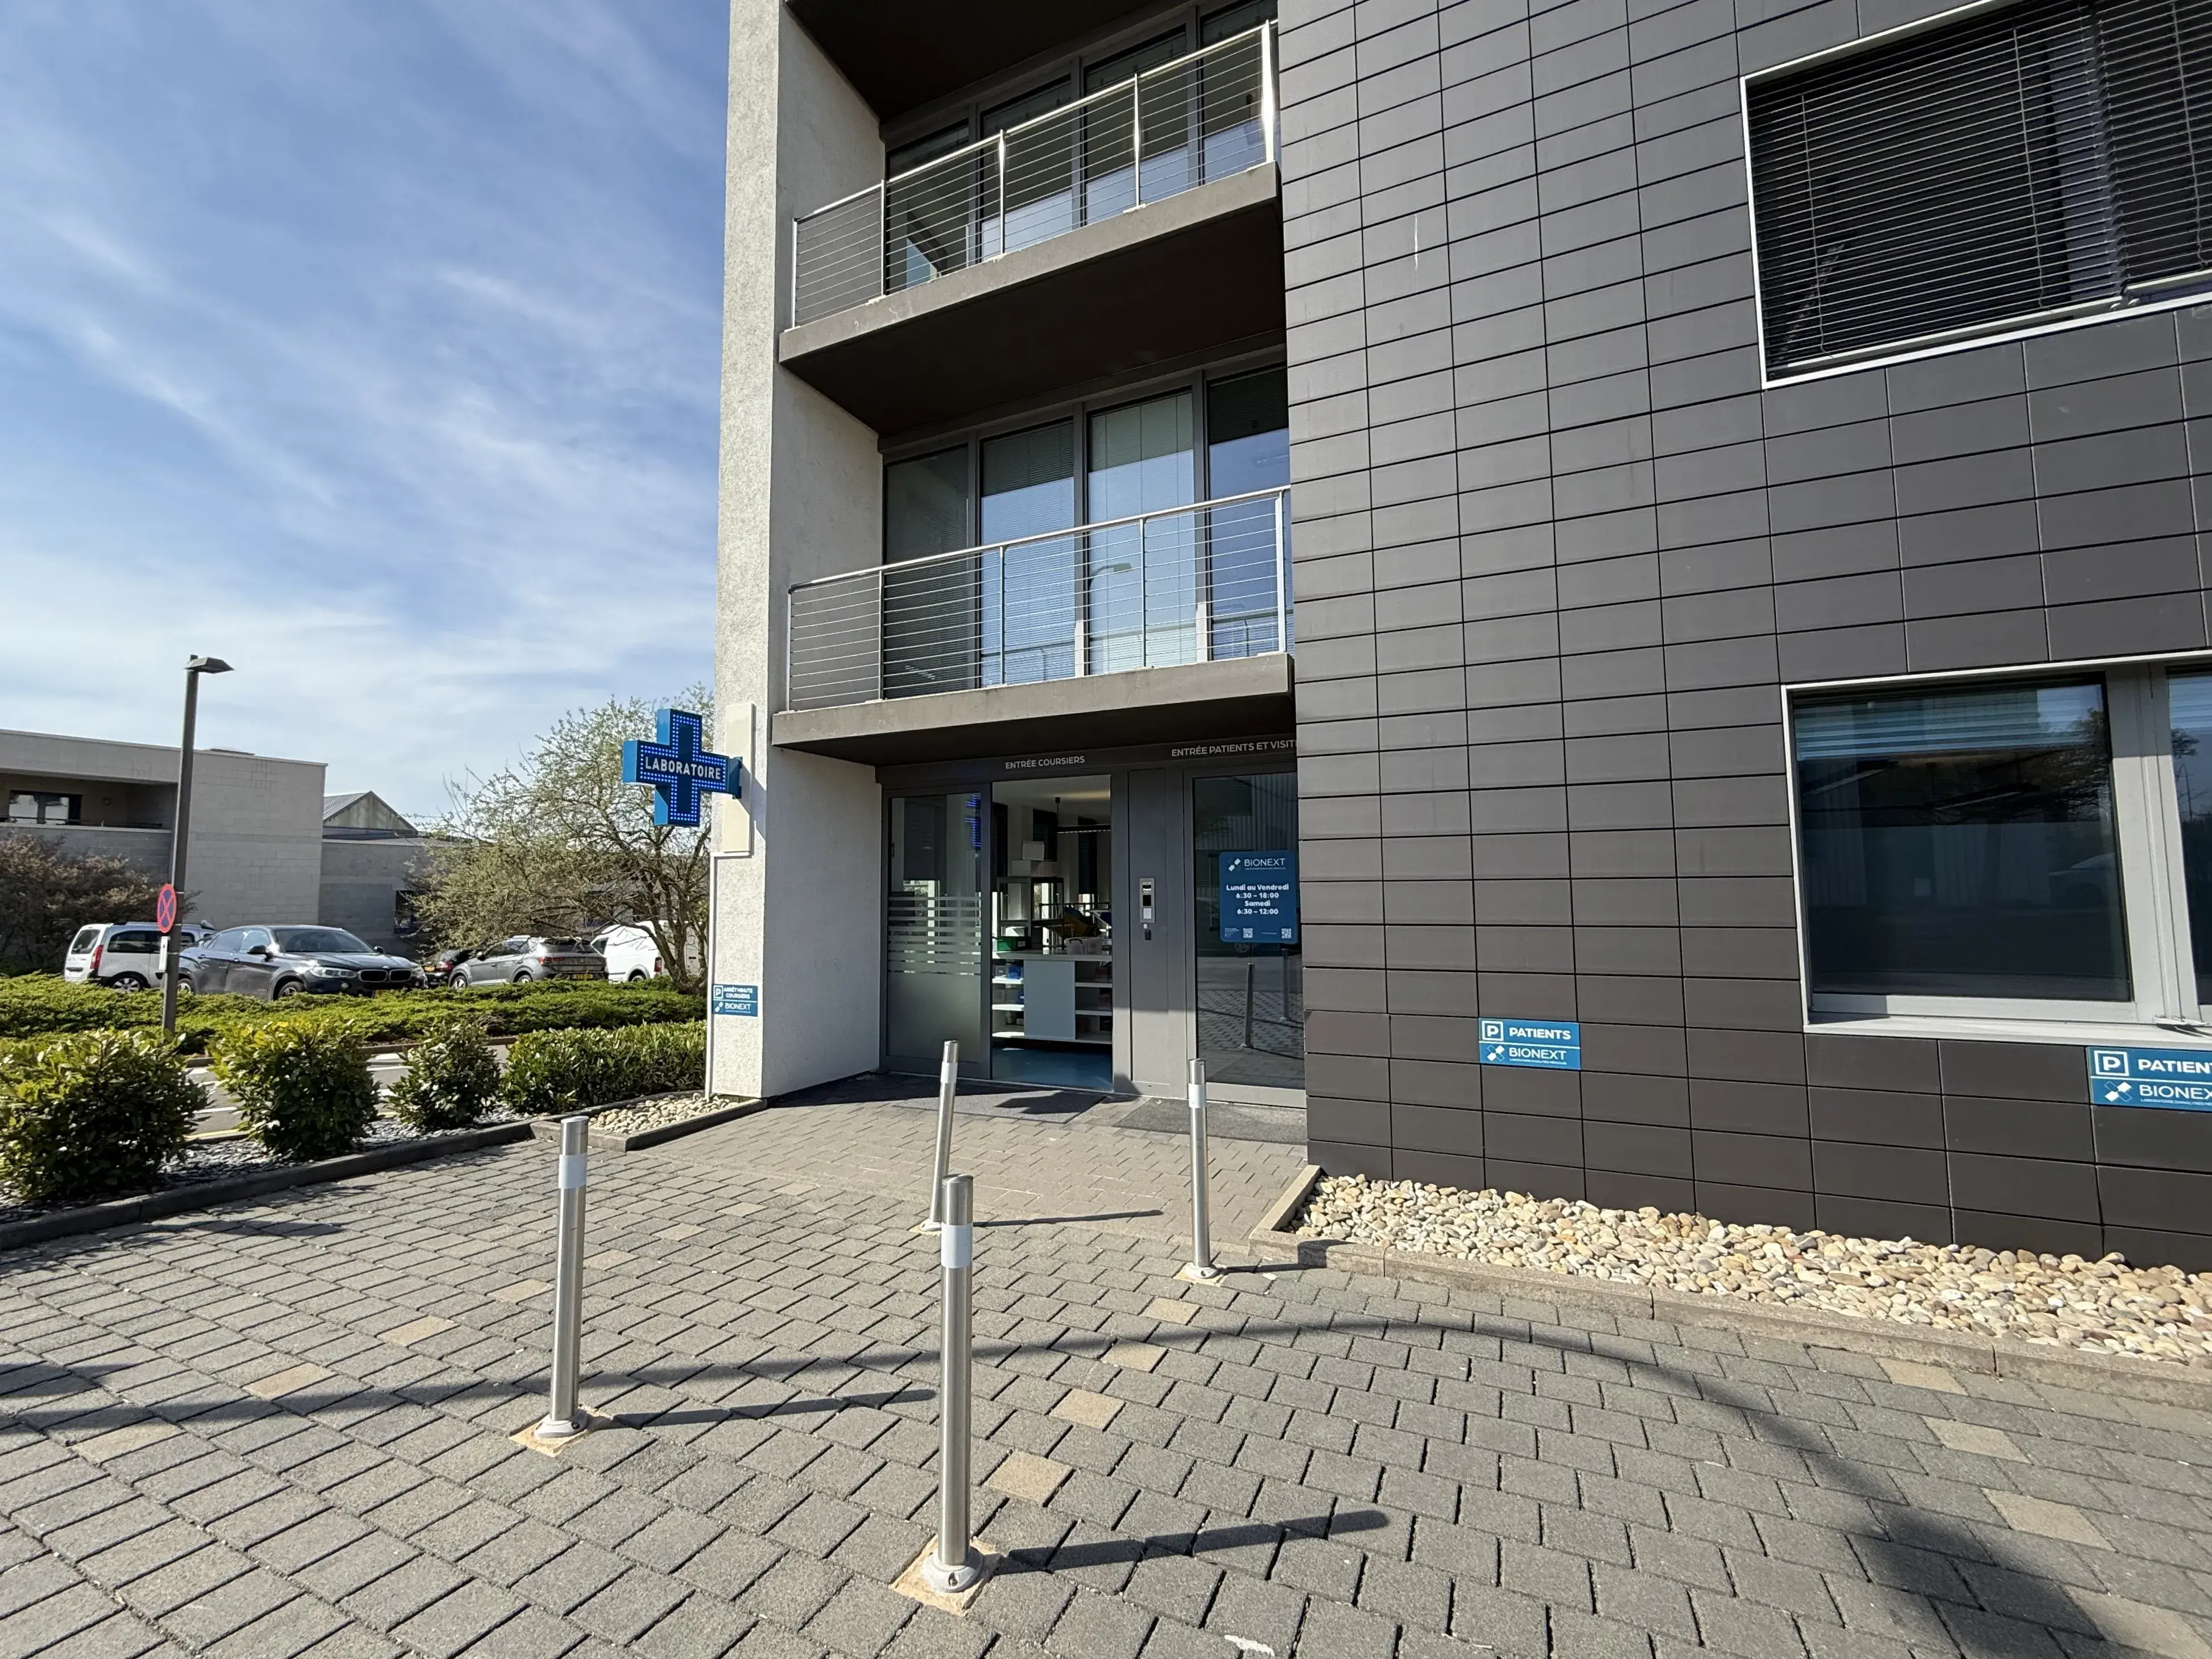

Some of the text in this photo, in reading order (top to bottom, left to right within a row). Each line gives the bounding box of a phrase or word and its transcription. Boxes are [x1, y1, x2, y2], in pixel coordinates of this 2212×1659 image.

[1171, 739, 1297, 757] ENTRÉE PATIENTS ET VISIT
[645, 756, 721, 780] LABORATOIRE
[1005, 756, 1085, 769] ENTRÉE COURSIERS
[1244, 858, 1286, 867] BIONEXT
[1487, 1025, 1499, 1037] P
[1509, 1027, 1572, 1040] PATIENTS
[1509, 1047, 1567, 1060] BIONEXT
[2102, 1056, 2121, 1071] P
